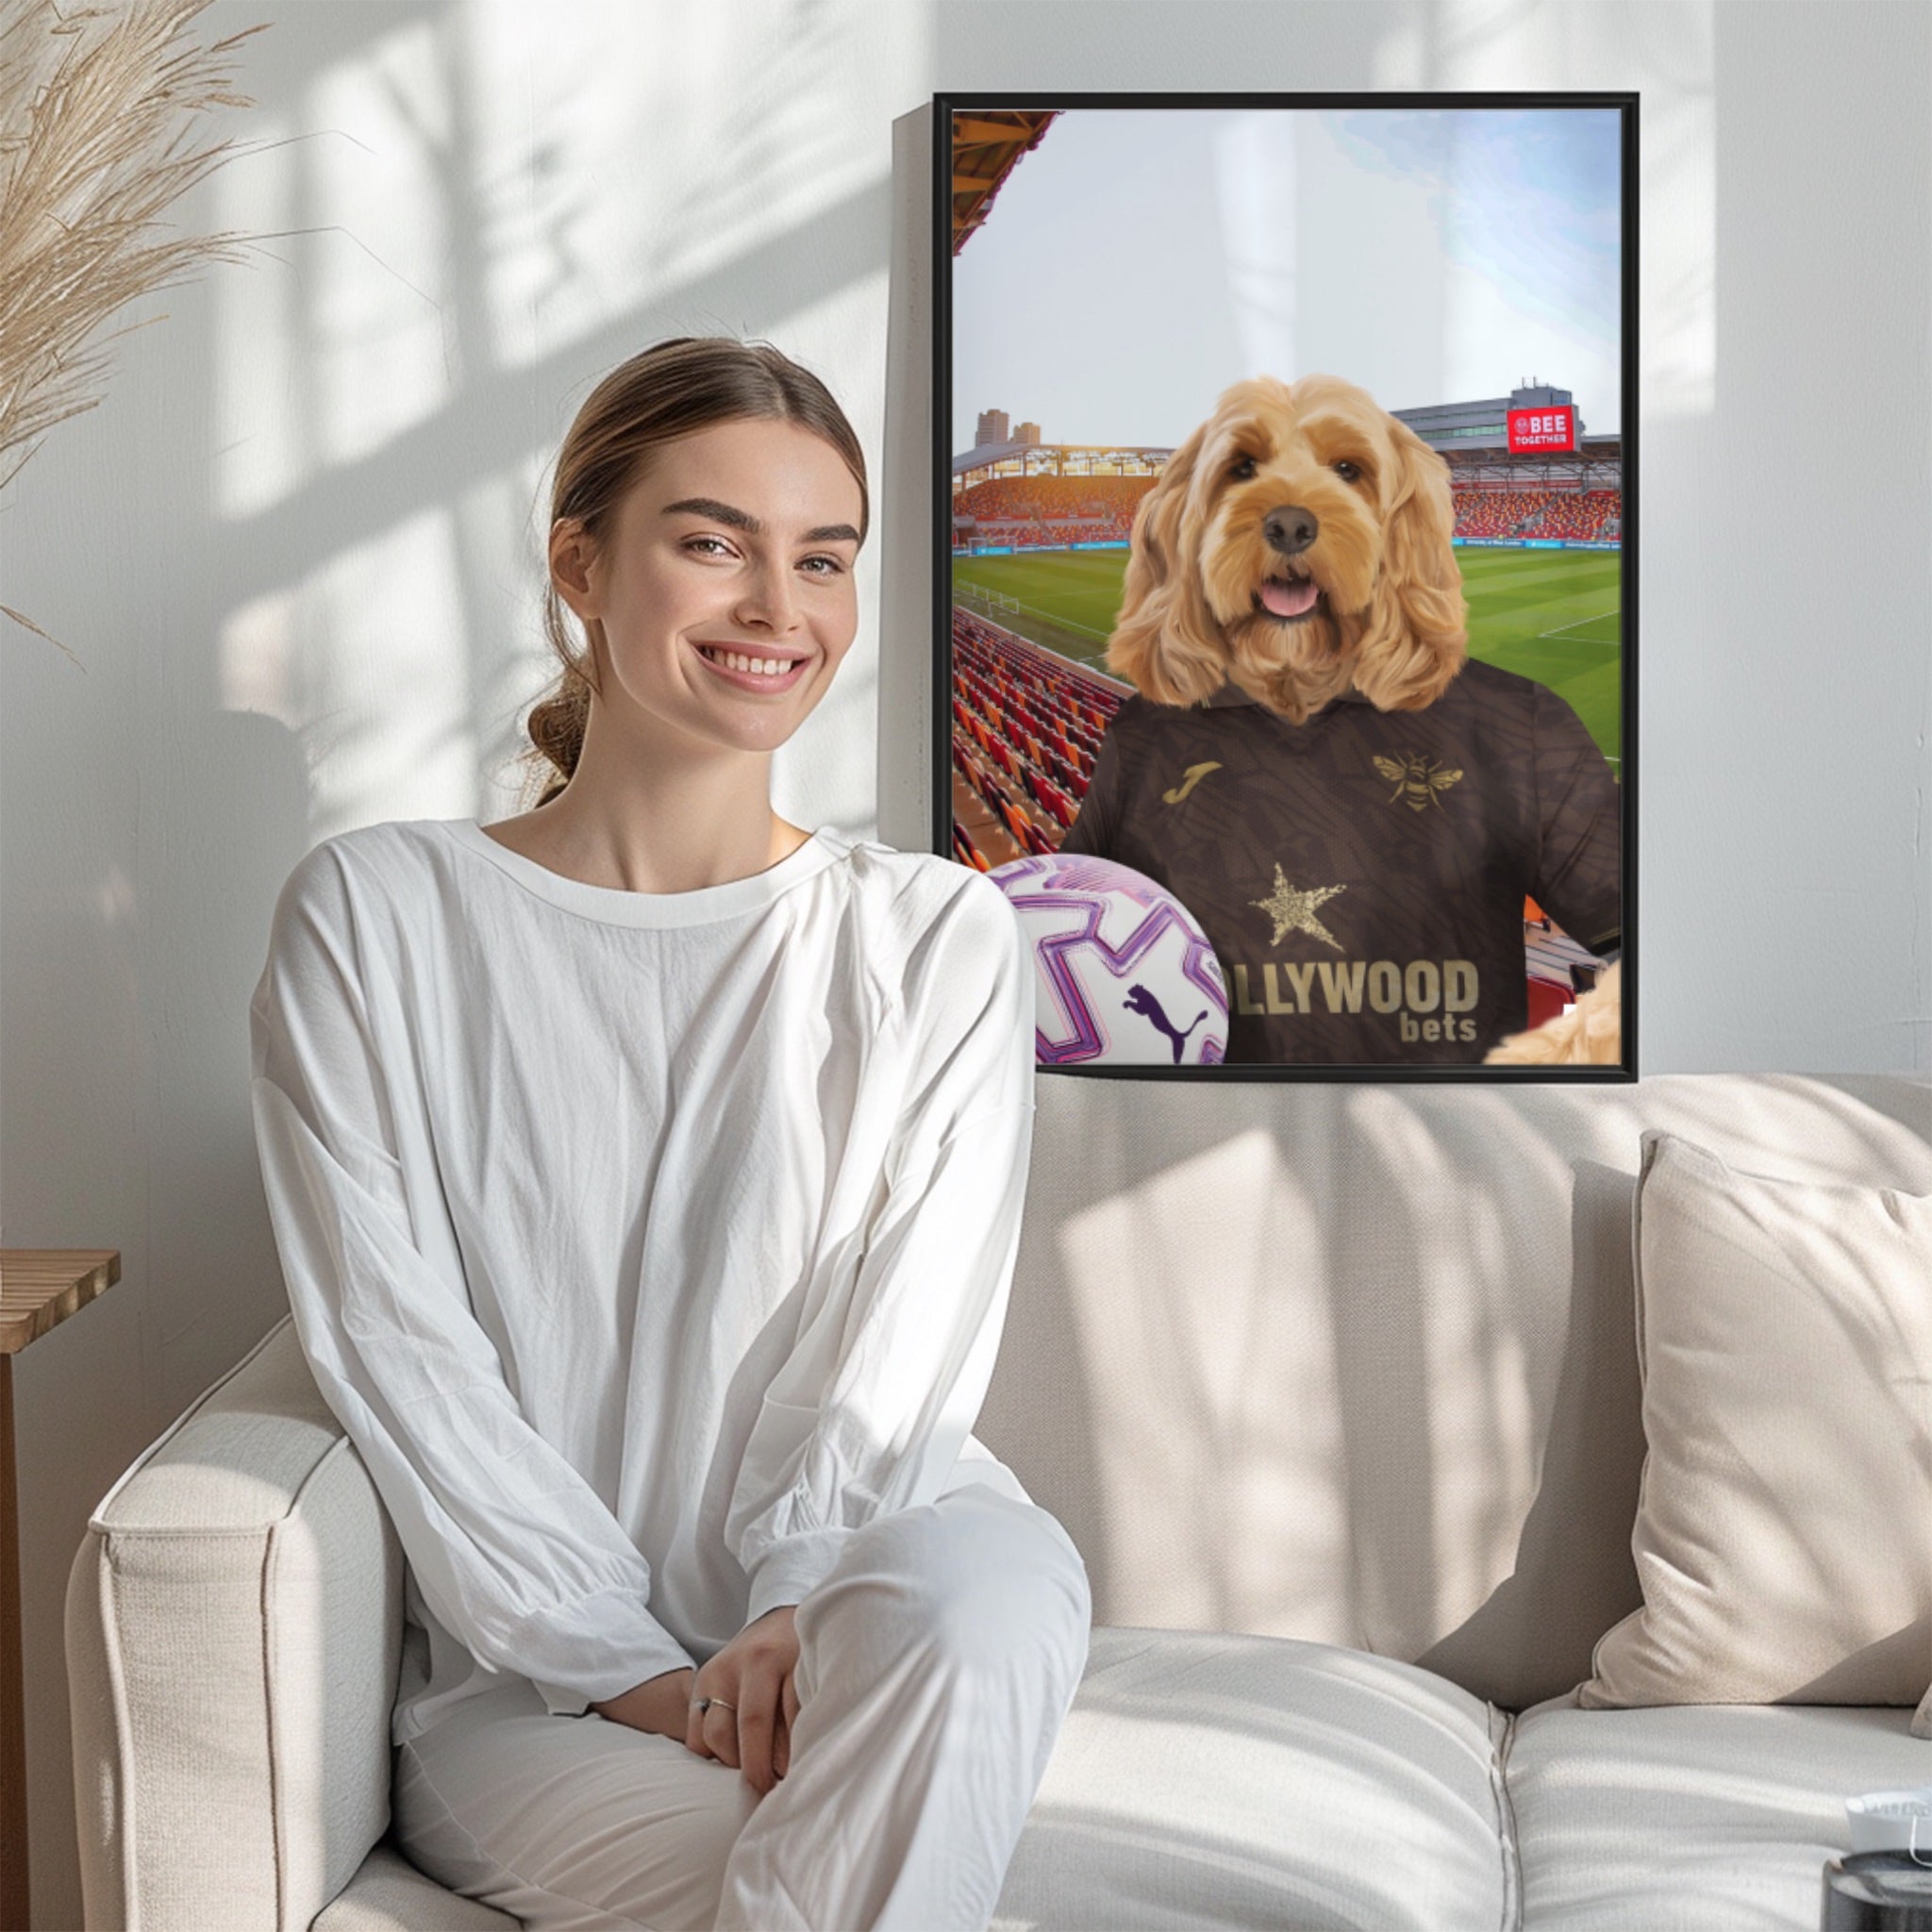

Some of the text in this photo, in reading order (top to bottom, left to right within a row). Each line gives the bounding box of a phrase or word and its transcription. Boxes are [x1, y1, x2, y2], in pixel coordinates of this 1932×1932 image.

[1529, 415, 1566, 434] BEE
[1514, 434, 1566, 445] TOGETHER
[1223, 959, 1479, 1015] LLYWOOD
[1399, 1011, 1477, 1041] bets
